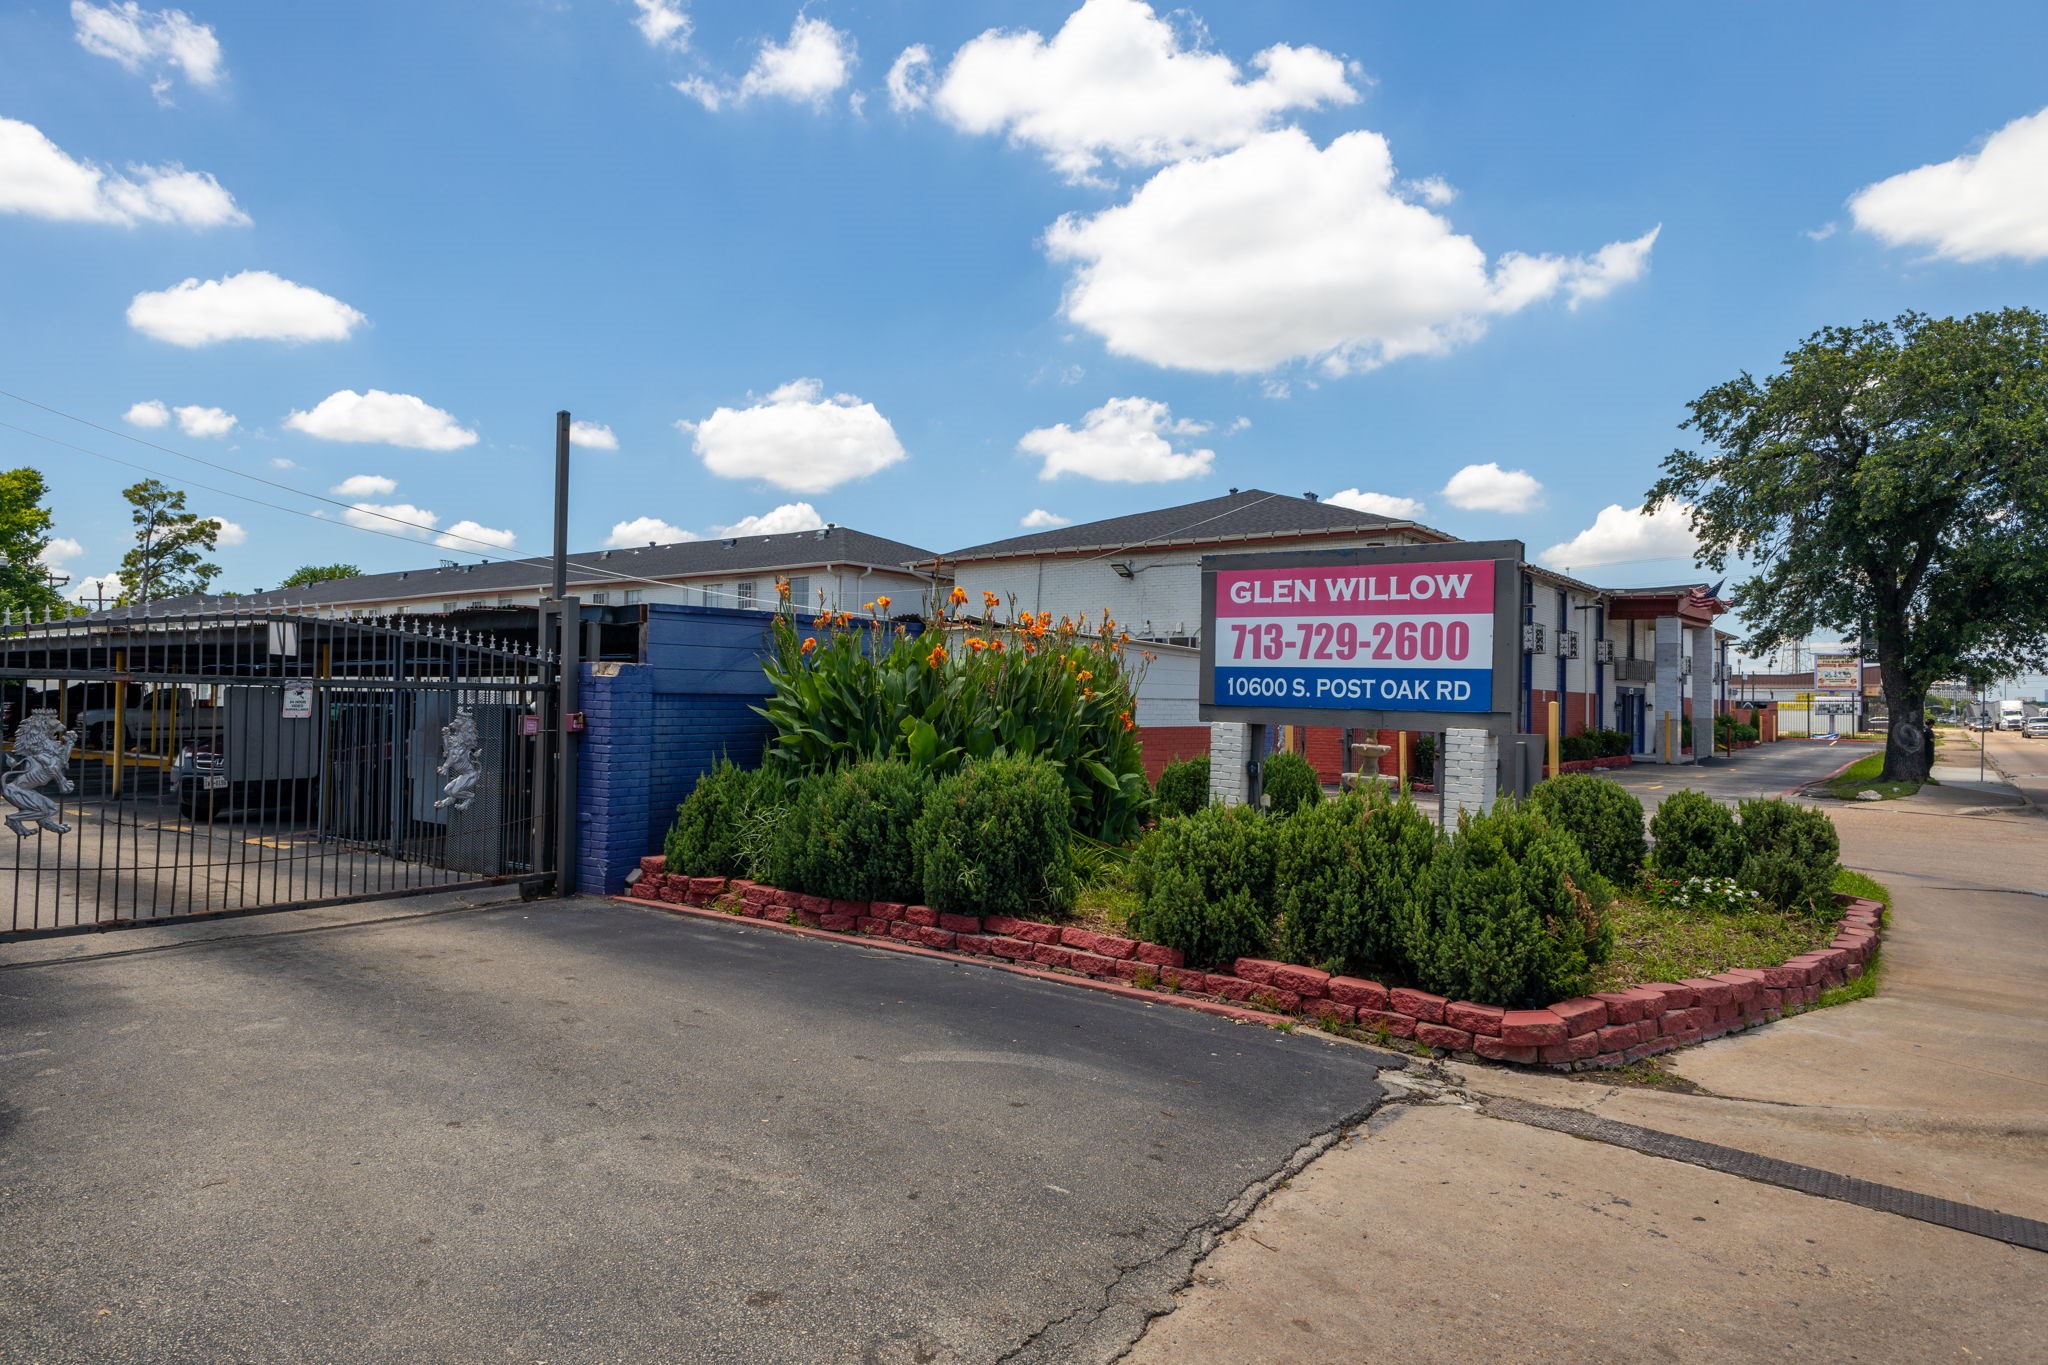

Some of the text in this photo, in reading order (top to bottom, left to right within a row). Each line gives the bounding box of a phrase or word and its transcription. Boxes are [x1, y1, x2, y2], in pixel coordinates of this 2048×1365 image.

[1230, 573, 1473, 604] GLEN WILLOW
[1231, 621, 1470, 661] 713-729-2600
[1228, 677, 1471, 701] 10600 S. POST OAK RD
